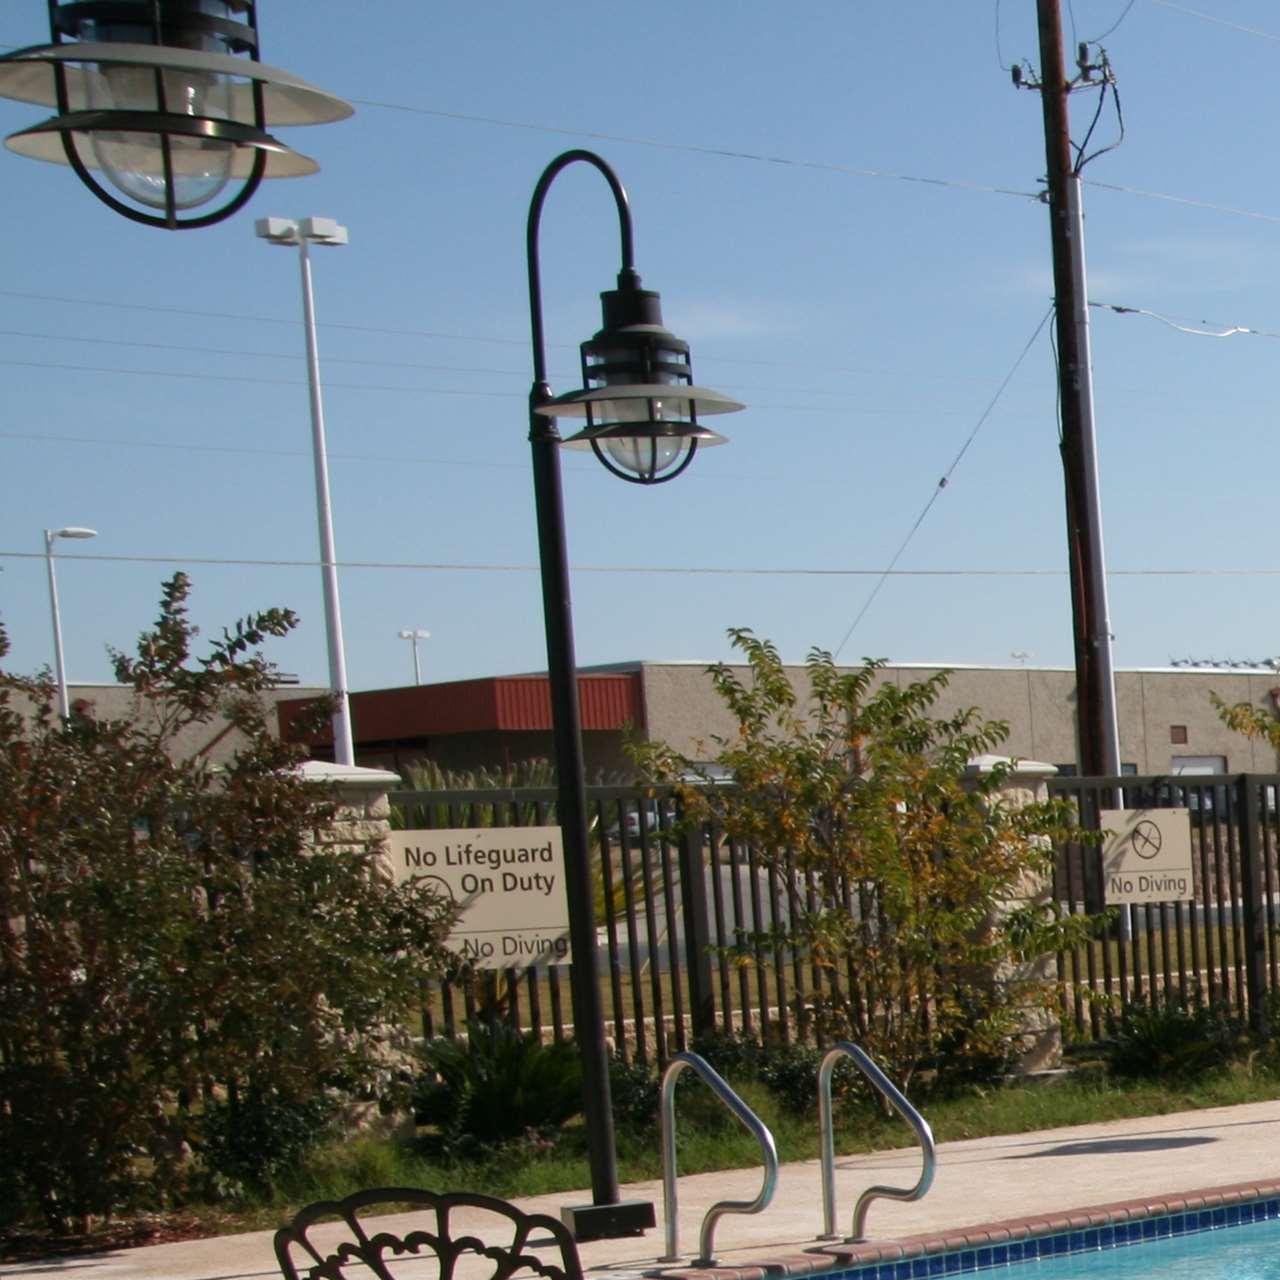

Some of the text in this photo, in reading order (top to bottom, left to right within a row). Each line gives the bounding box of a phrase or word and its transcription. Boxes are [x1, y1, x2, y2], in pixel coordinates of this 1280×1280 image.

[404, 841, 553, 870] No Lifeguard
[460, 871, 556, 896] On Duty
[1111, 874, 1187, 894] No Diving
[463, 933, 569, 959] No Diving
